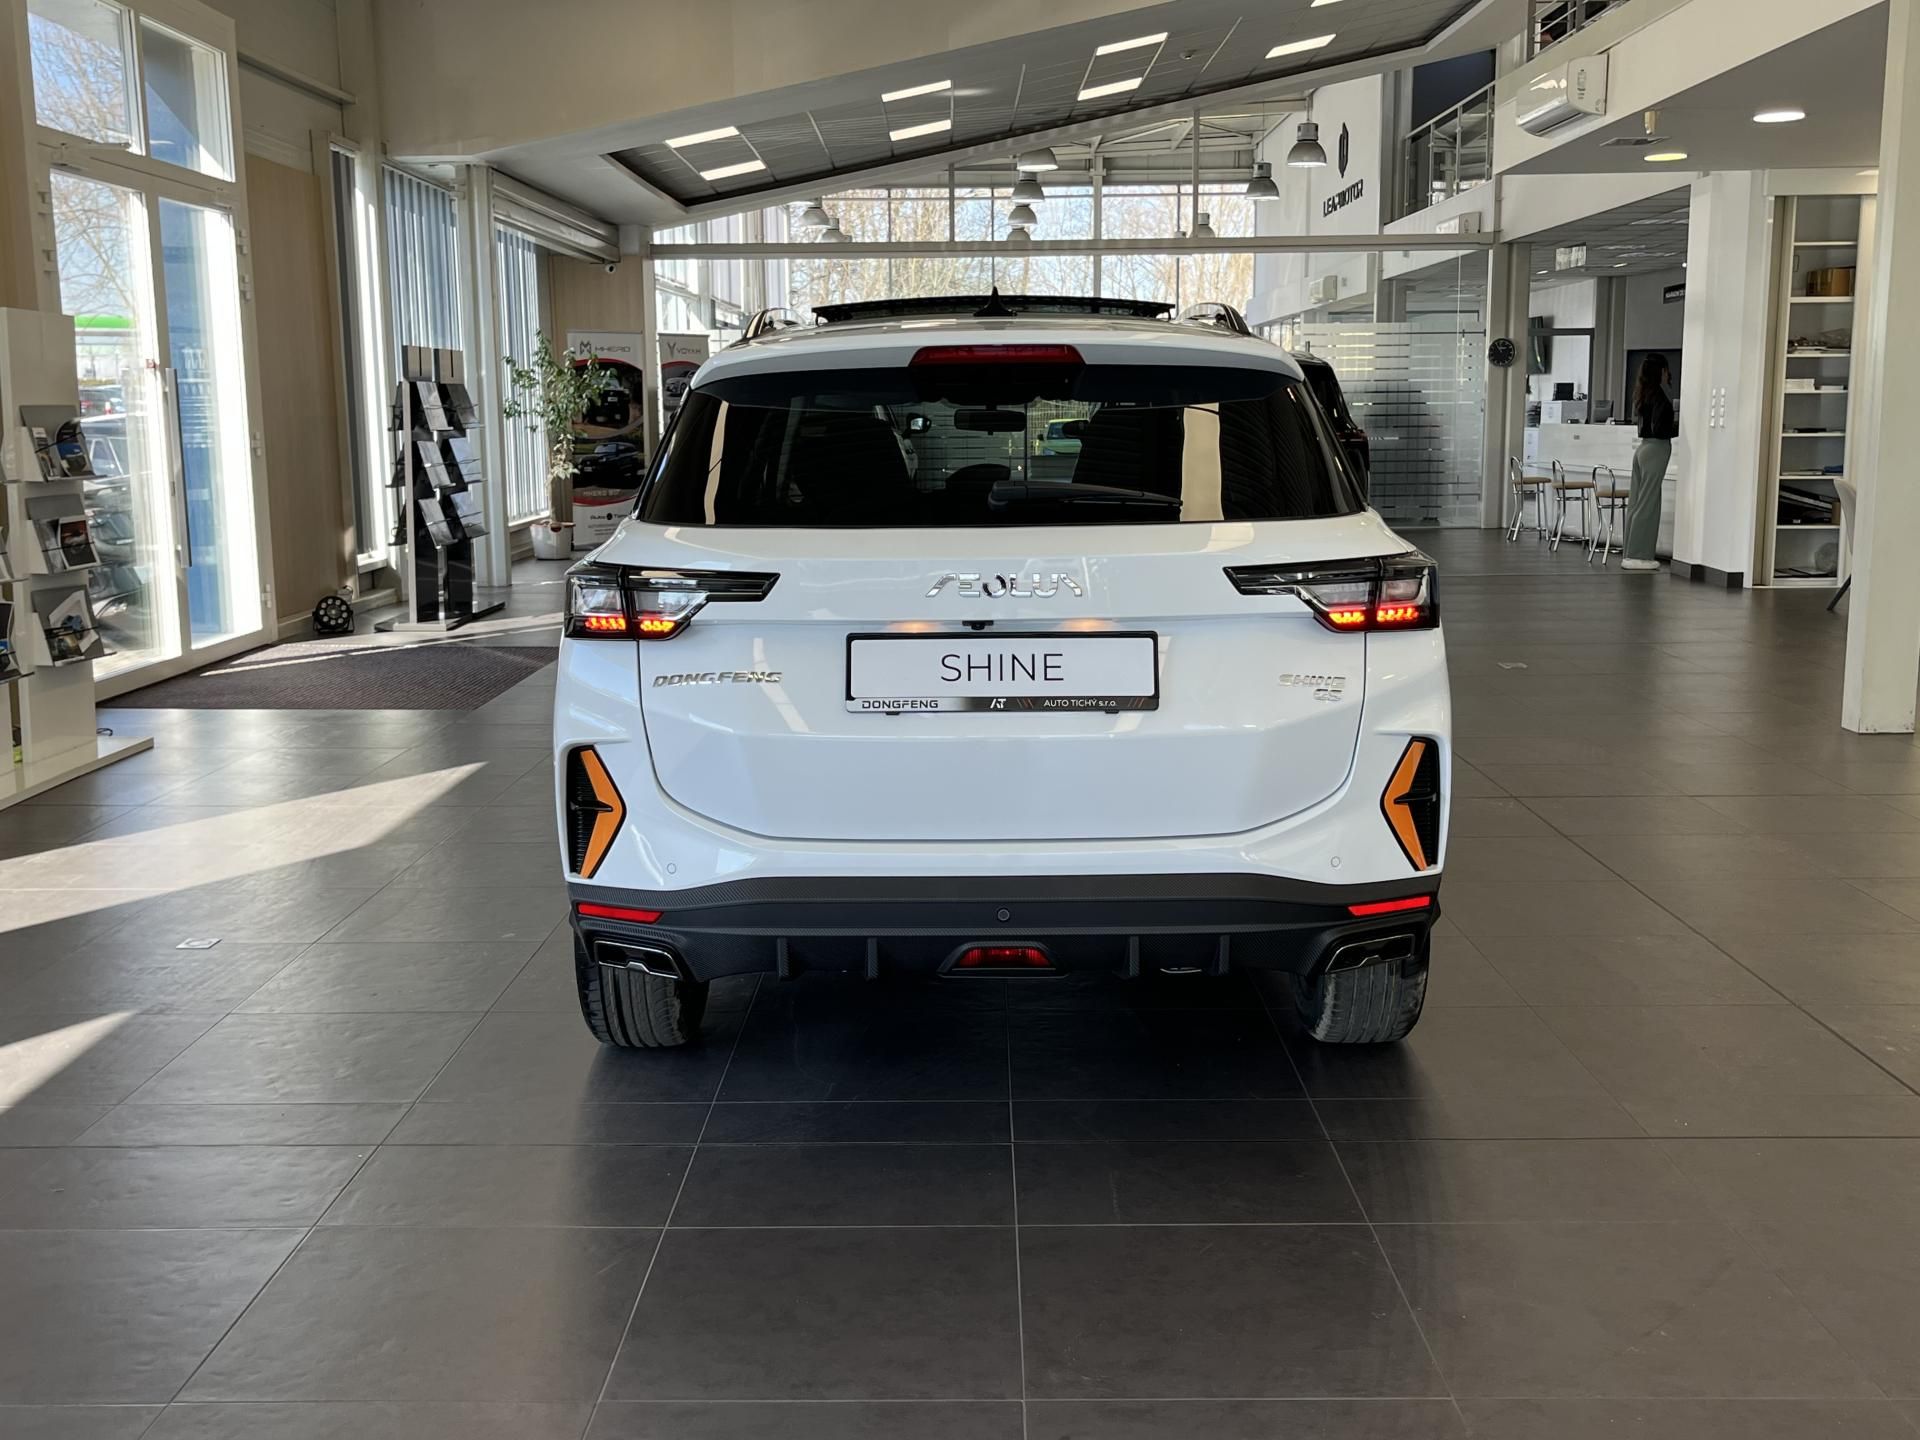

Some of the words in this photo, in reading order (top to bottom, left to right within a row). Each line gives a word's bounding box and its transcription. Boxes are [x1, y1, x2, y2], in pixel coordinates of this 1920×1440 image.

[941, 653, 1064, 682] SHINE
[653, 671, 783, 687] DONGFENG
[1279, 674, 1346, 688] SHINE
[862, 700, 939, 709] DONGFENG
[1043, 699, 1069, 707] AUTO
[1070, 698, 1097, 707] TICHÝ
